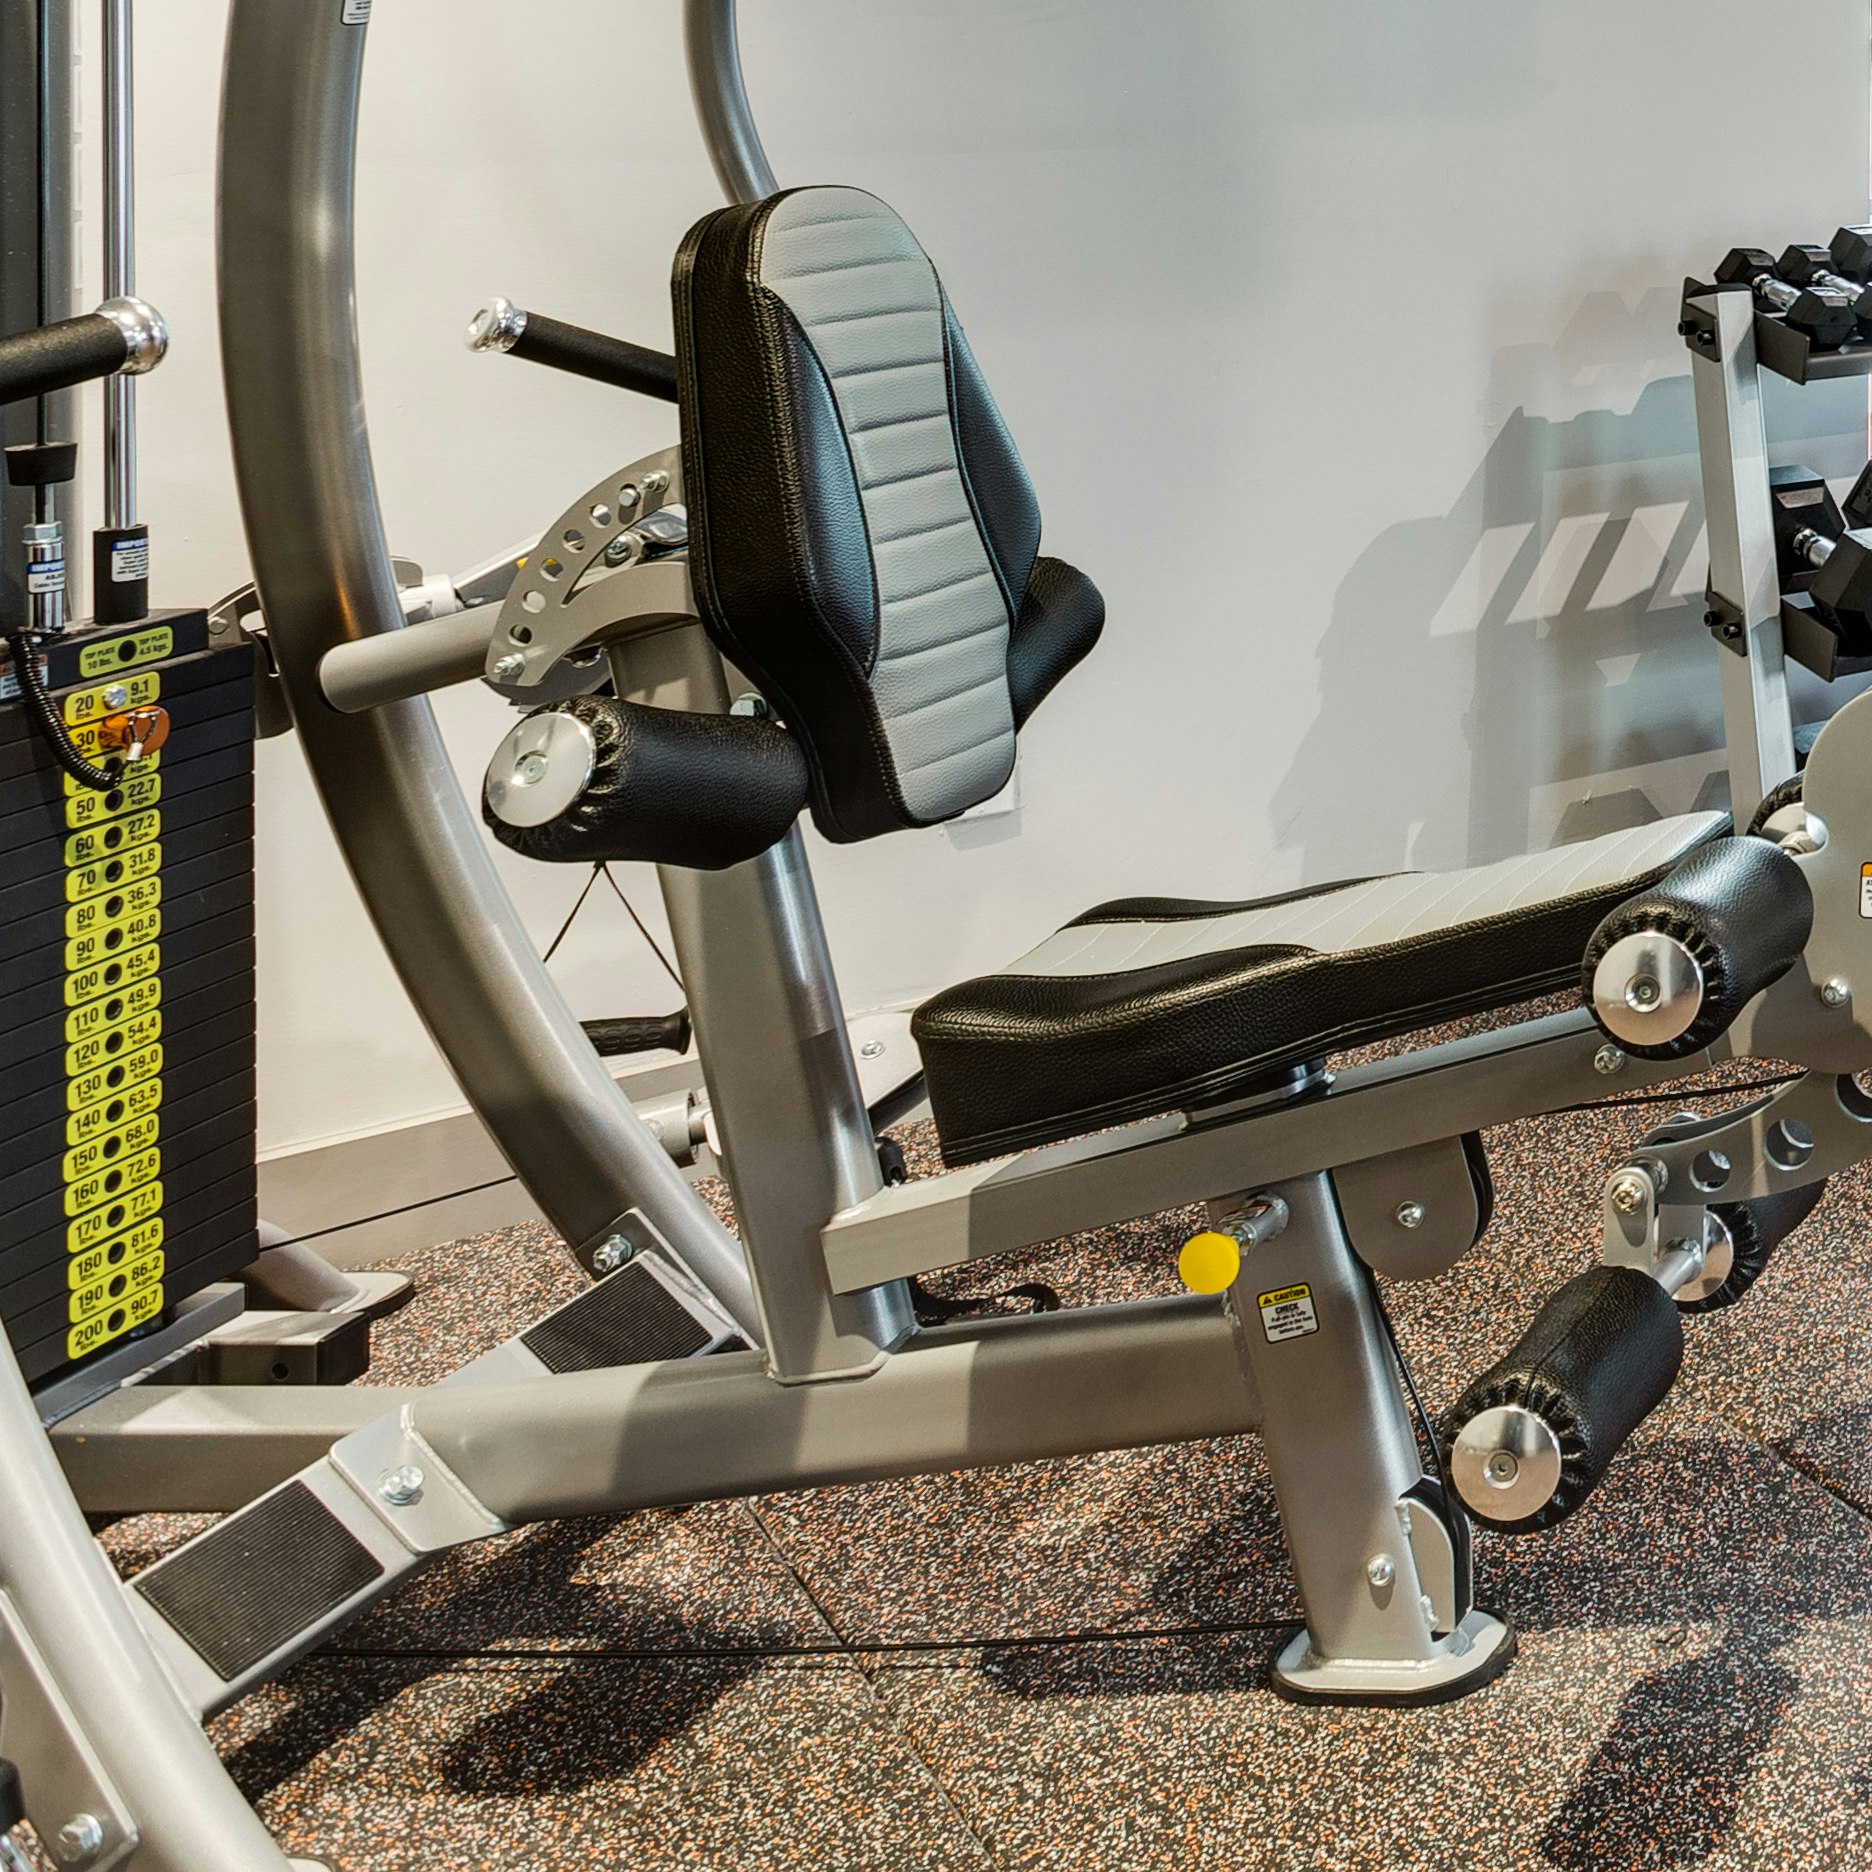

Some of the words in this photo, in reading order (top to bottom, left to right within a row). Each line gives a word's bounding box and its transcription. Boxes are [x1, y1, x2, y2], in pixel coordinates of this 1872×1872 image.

[87, 660, 97, 670] 10
[75, 695, 94, 713] 20
[131, 679, 149, 696] 9.1
[77, 730, 95, 747] 30
[76, 797, 95, 815] 50
[127, 778, 155, 798] 22.7
[75, 835, 94, 854] 60
[127, 814, 155, 834] 27.2
[77, 869, 96, 888] 70
[129, 848, 155, 868] 31.8
[77, 905, 95, 924] 80
[128, 882, 157, 903] 36.3
[76, 937, 95, 957] 90
[127, 914, 157, 935] 40.8
[72, 971, 98, 993] 100
[126, 949, 155, 970] 45.4
[74, 1007, 99, 1029] 110
[128, 983, 157, 1004] 49.9
[74, 1040, 99, 1063] 120
[128, 1016, 157, 1038] 54.4
[75, 1074, 101, 1097] 130
[129, 1049, 158, 1072] 59.0
[75, 1109, 100, 1132] 140
[128, 1084, 158, 1107] 63.5
[72, 1146, 97, 1168] 150
[126, 1119, 155, 1142] 68.0
[73, 1179, 99, 1203] 160
[127, 1153, 156, 1177] 72.6
[76, 1215, 101, 1240] 170
[131, 1188, 156, 1210] 77.1
[76, 1252, 102, 1276] 180
[131, 1224, 158, 1248] 81.6
[78, 1285, 103, 1310] 190
[131, 1256, 160, 1281] 86.2
[1274, 1288, 1306, 1301] CAUTION
[75, 1319, 103, 1346] 200
[131, 1289, 158, 1314] 90.7
[1275, 1303, 1299, 1314] CHECK
